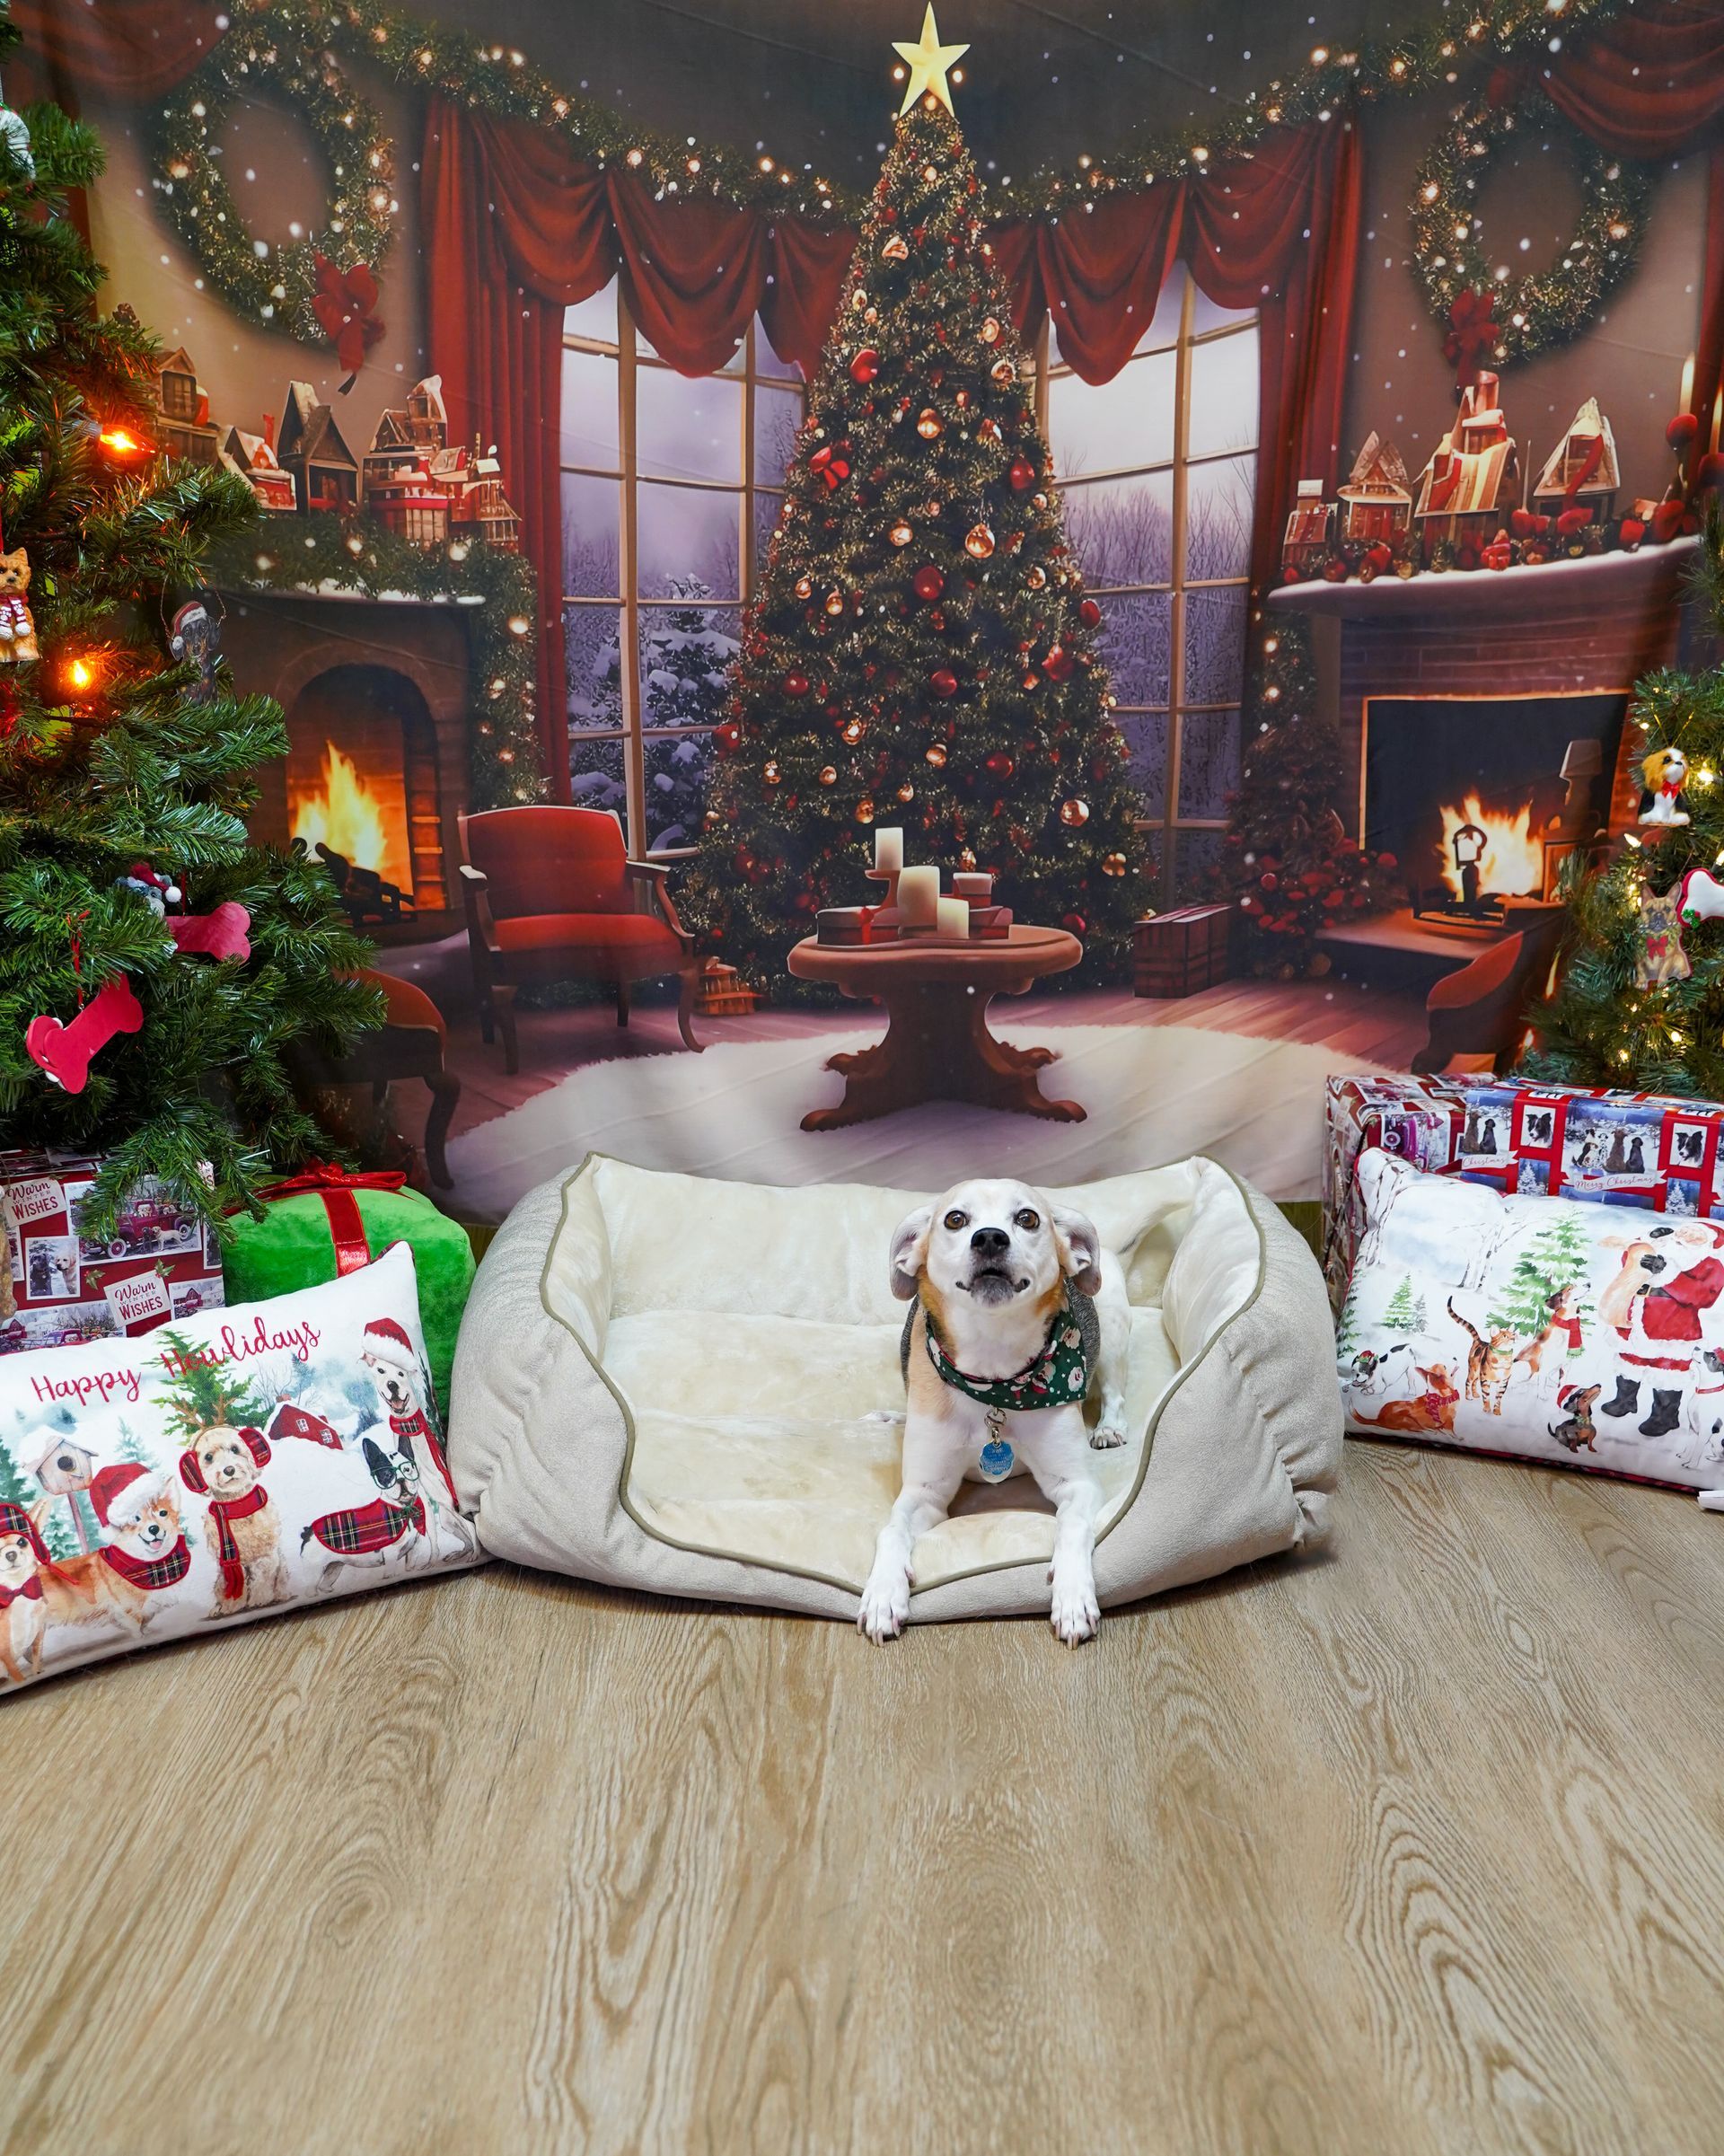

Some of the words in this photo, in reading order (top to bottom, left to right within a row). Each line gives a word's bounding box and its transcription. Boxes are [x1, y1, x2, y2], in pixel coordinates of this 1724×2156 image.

[4, 1183, 50, 1201] Warm
[1575, 1179, 1605, 1191] Merry
[1606, 1175, 1655, 1187] Christmas
[12, 1196, 58, 1220] WISHES
[114, 1281, 157, 1302] Warm
[119, 1296, 163, 1321] WISHES
[30, 1368, 142, 1407] Happy
[160, 1316, 321, 1378] Howlidays
